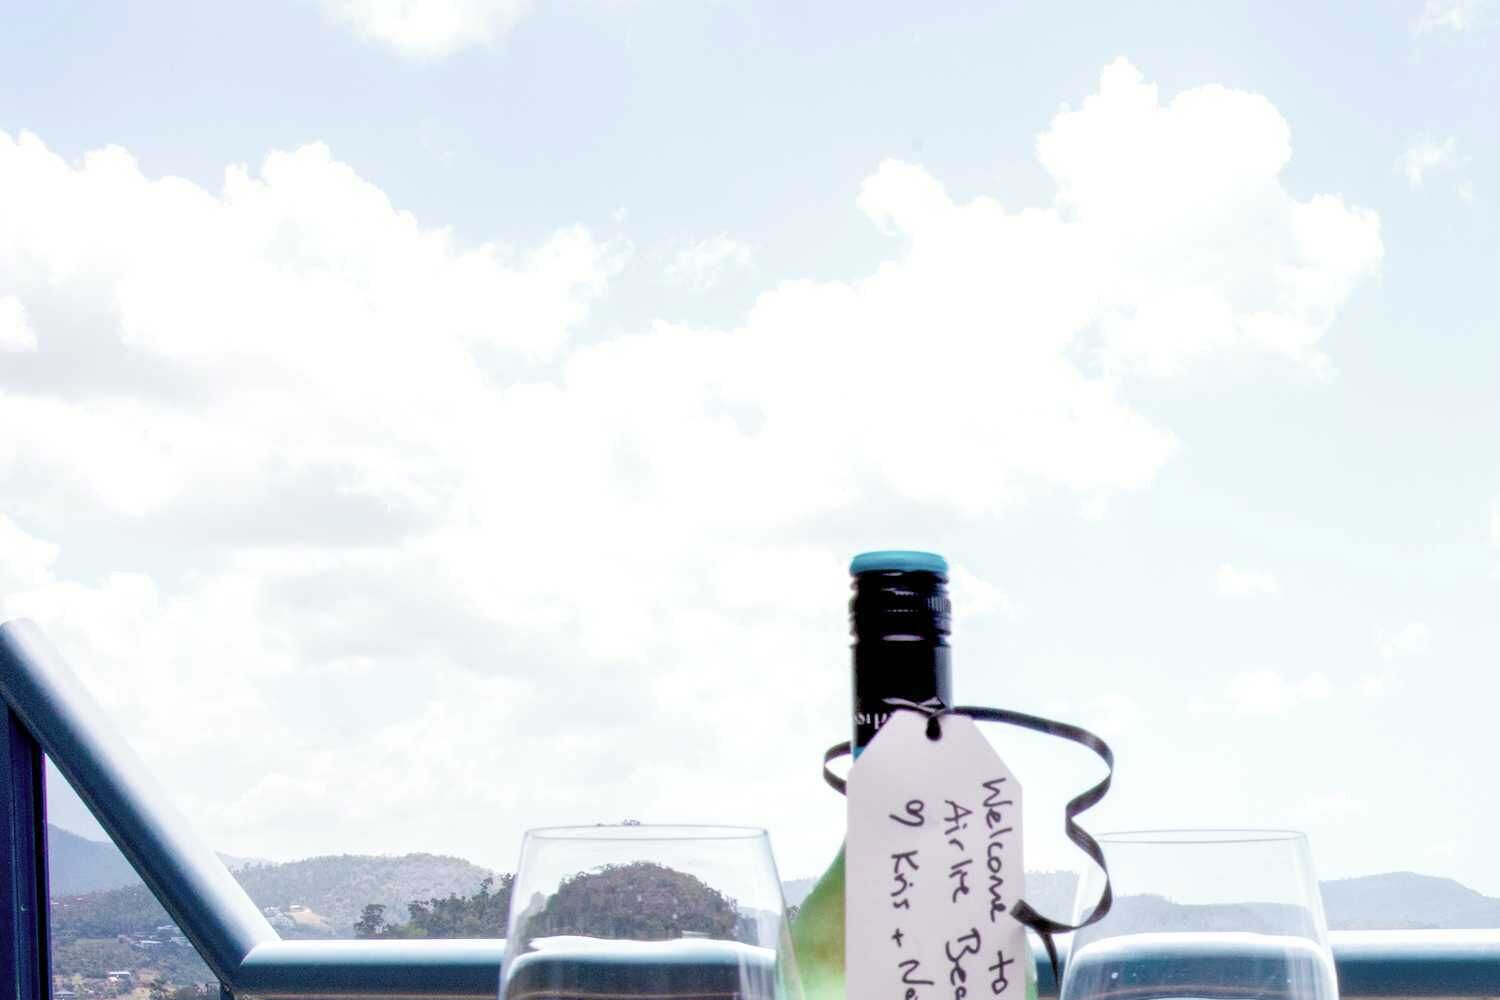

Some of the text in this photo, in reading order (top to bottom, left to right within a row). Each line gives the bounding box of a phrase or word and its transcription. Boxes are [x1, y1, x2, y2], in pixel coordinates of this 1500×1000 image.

[889, 850, 921, 910] Kris
[982, 777, 1015, 996] Welcome to
